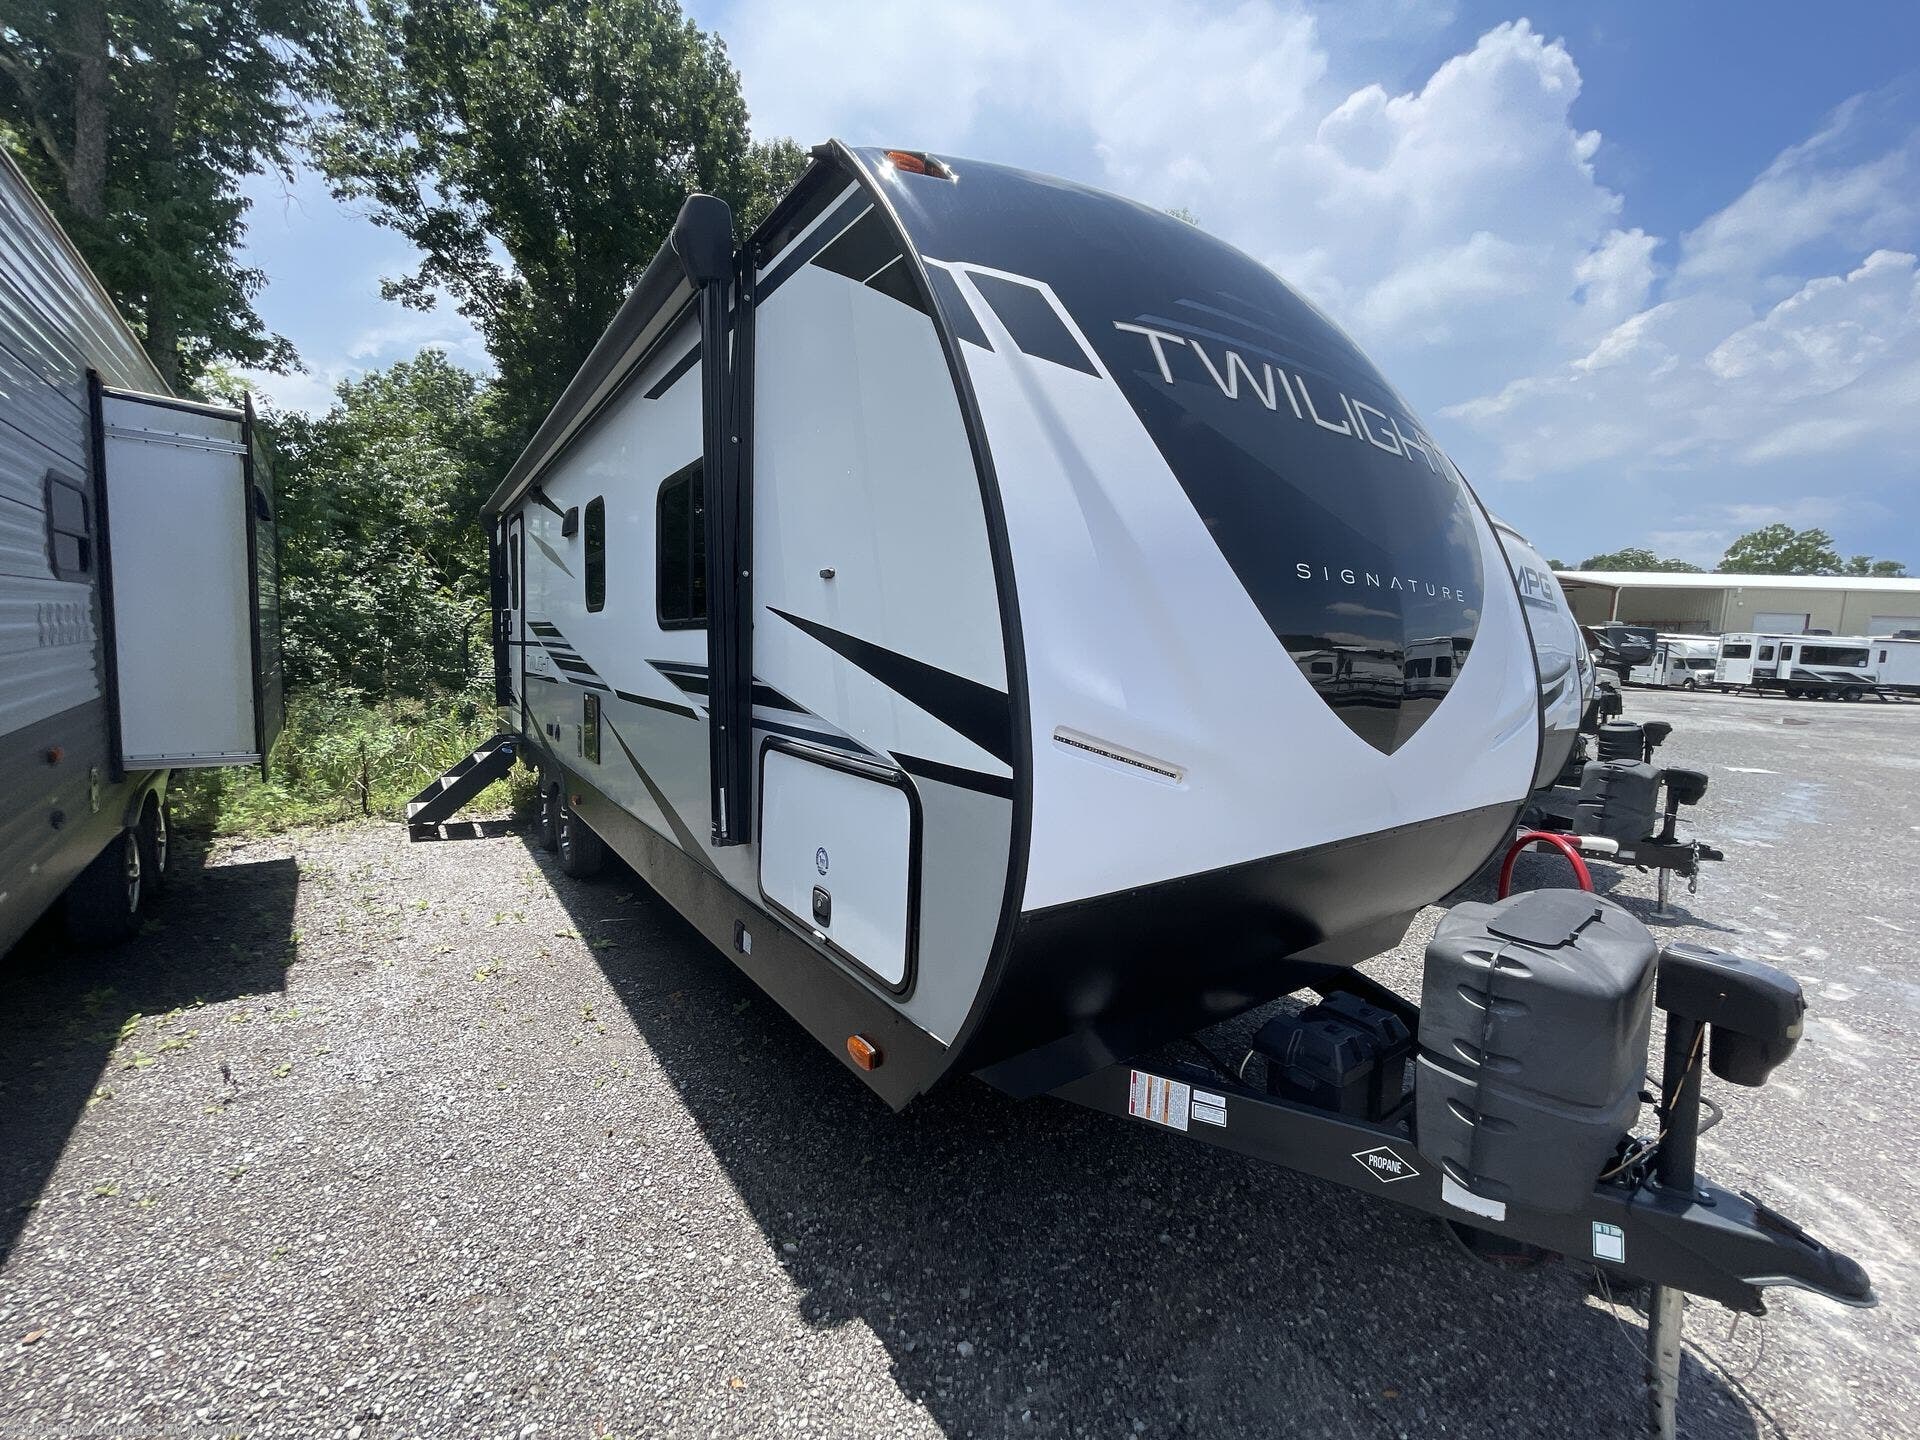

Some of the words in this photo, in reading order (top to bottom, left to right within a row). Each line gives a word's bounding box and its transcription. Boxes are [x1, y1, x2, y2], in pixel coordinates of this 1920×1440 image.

[1112, 320, 1452, 482] TWILIGHT
[1296, 563, 1465, 602] SIGNATURE
[1368, 1154, 1402, 1174] PROPANE
